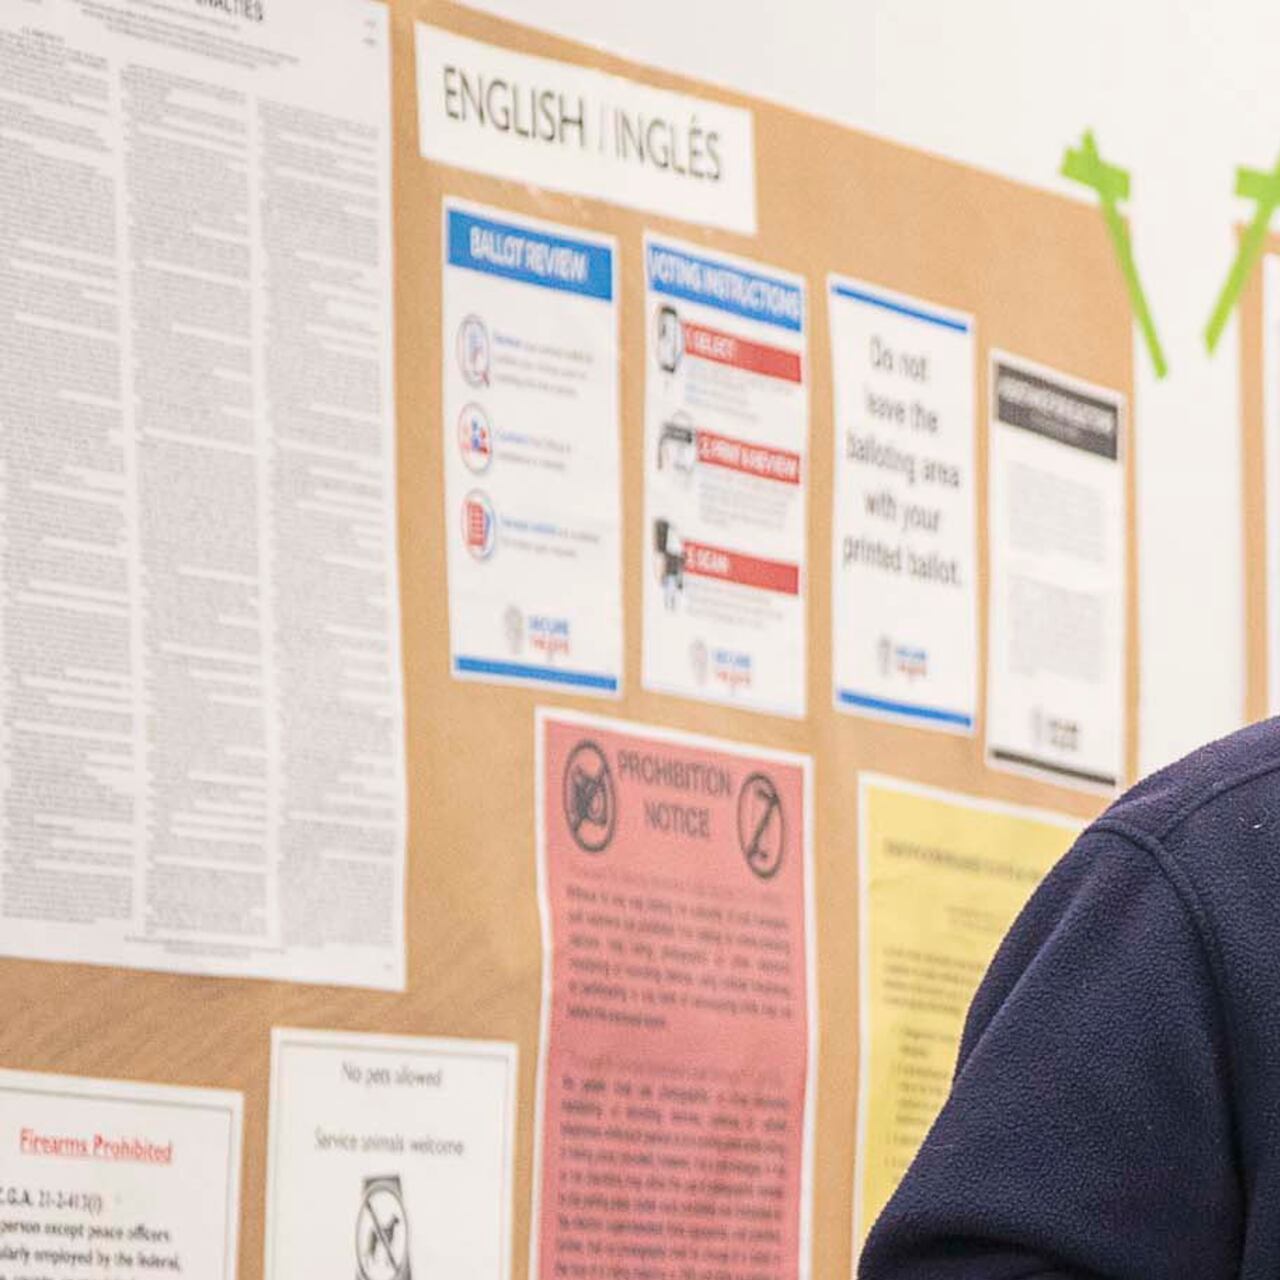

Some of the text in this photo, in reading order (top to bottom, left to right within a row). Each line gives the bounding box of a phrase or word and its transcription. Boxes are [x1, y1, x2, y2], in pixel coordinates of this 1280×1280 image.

[443, 64, 722, 182] ENGLISH INGLÉS
[470, 226, 588, 284] BALLOT REVIEW
[650, 250, 801, 322] VOTING INSTRUCTIONS
[870, 335, 929, 382] Do not
[864, 383, 939, 433] leave the
[846, 428, 960, 489] balloting area
[864, 491, 941, 532] with your
[842, 535, 902, 574] printed
[617, 748, 731, 797] PROHIBITION
[643, 799, 711, 839] NOTICE
[341, 1061, 443, 1088] No pets allowed
[20, 1127, 172, 1162] Firearms Prohibited
[314, 1124, 465, 1155] Service animals welcome
[44, 1222, 84, 1240] except
[88, 1225, 124, 1241] peace
[128, 1223, 171, 1242] officers
[34, 1249, 94, 1268] employed
[97, 1250, 110, 1268] by
[114, 1252, 133, 1267] the
